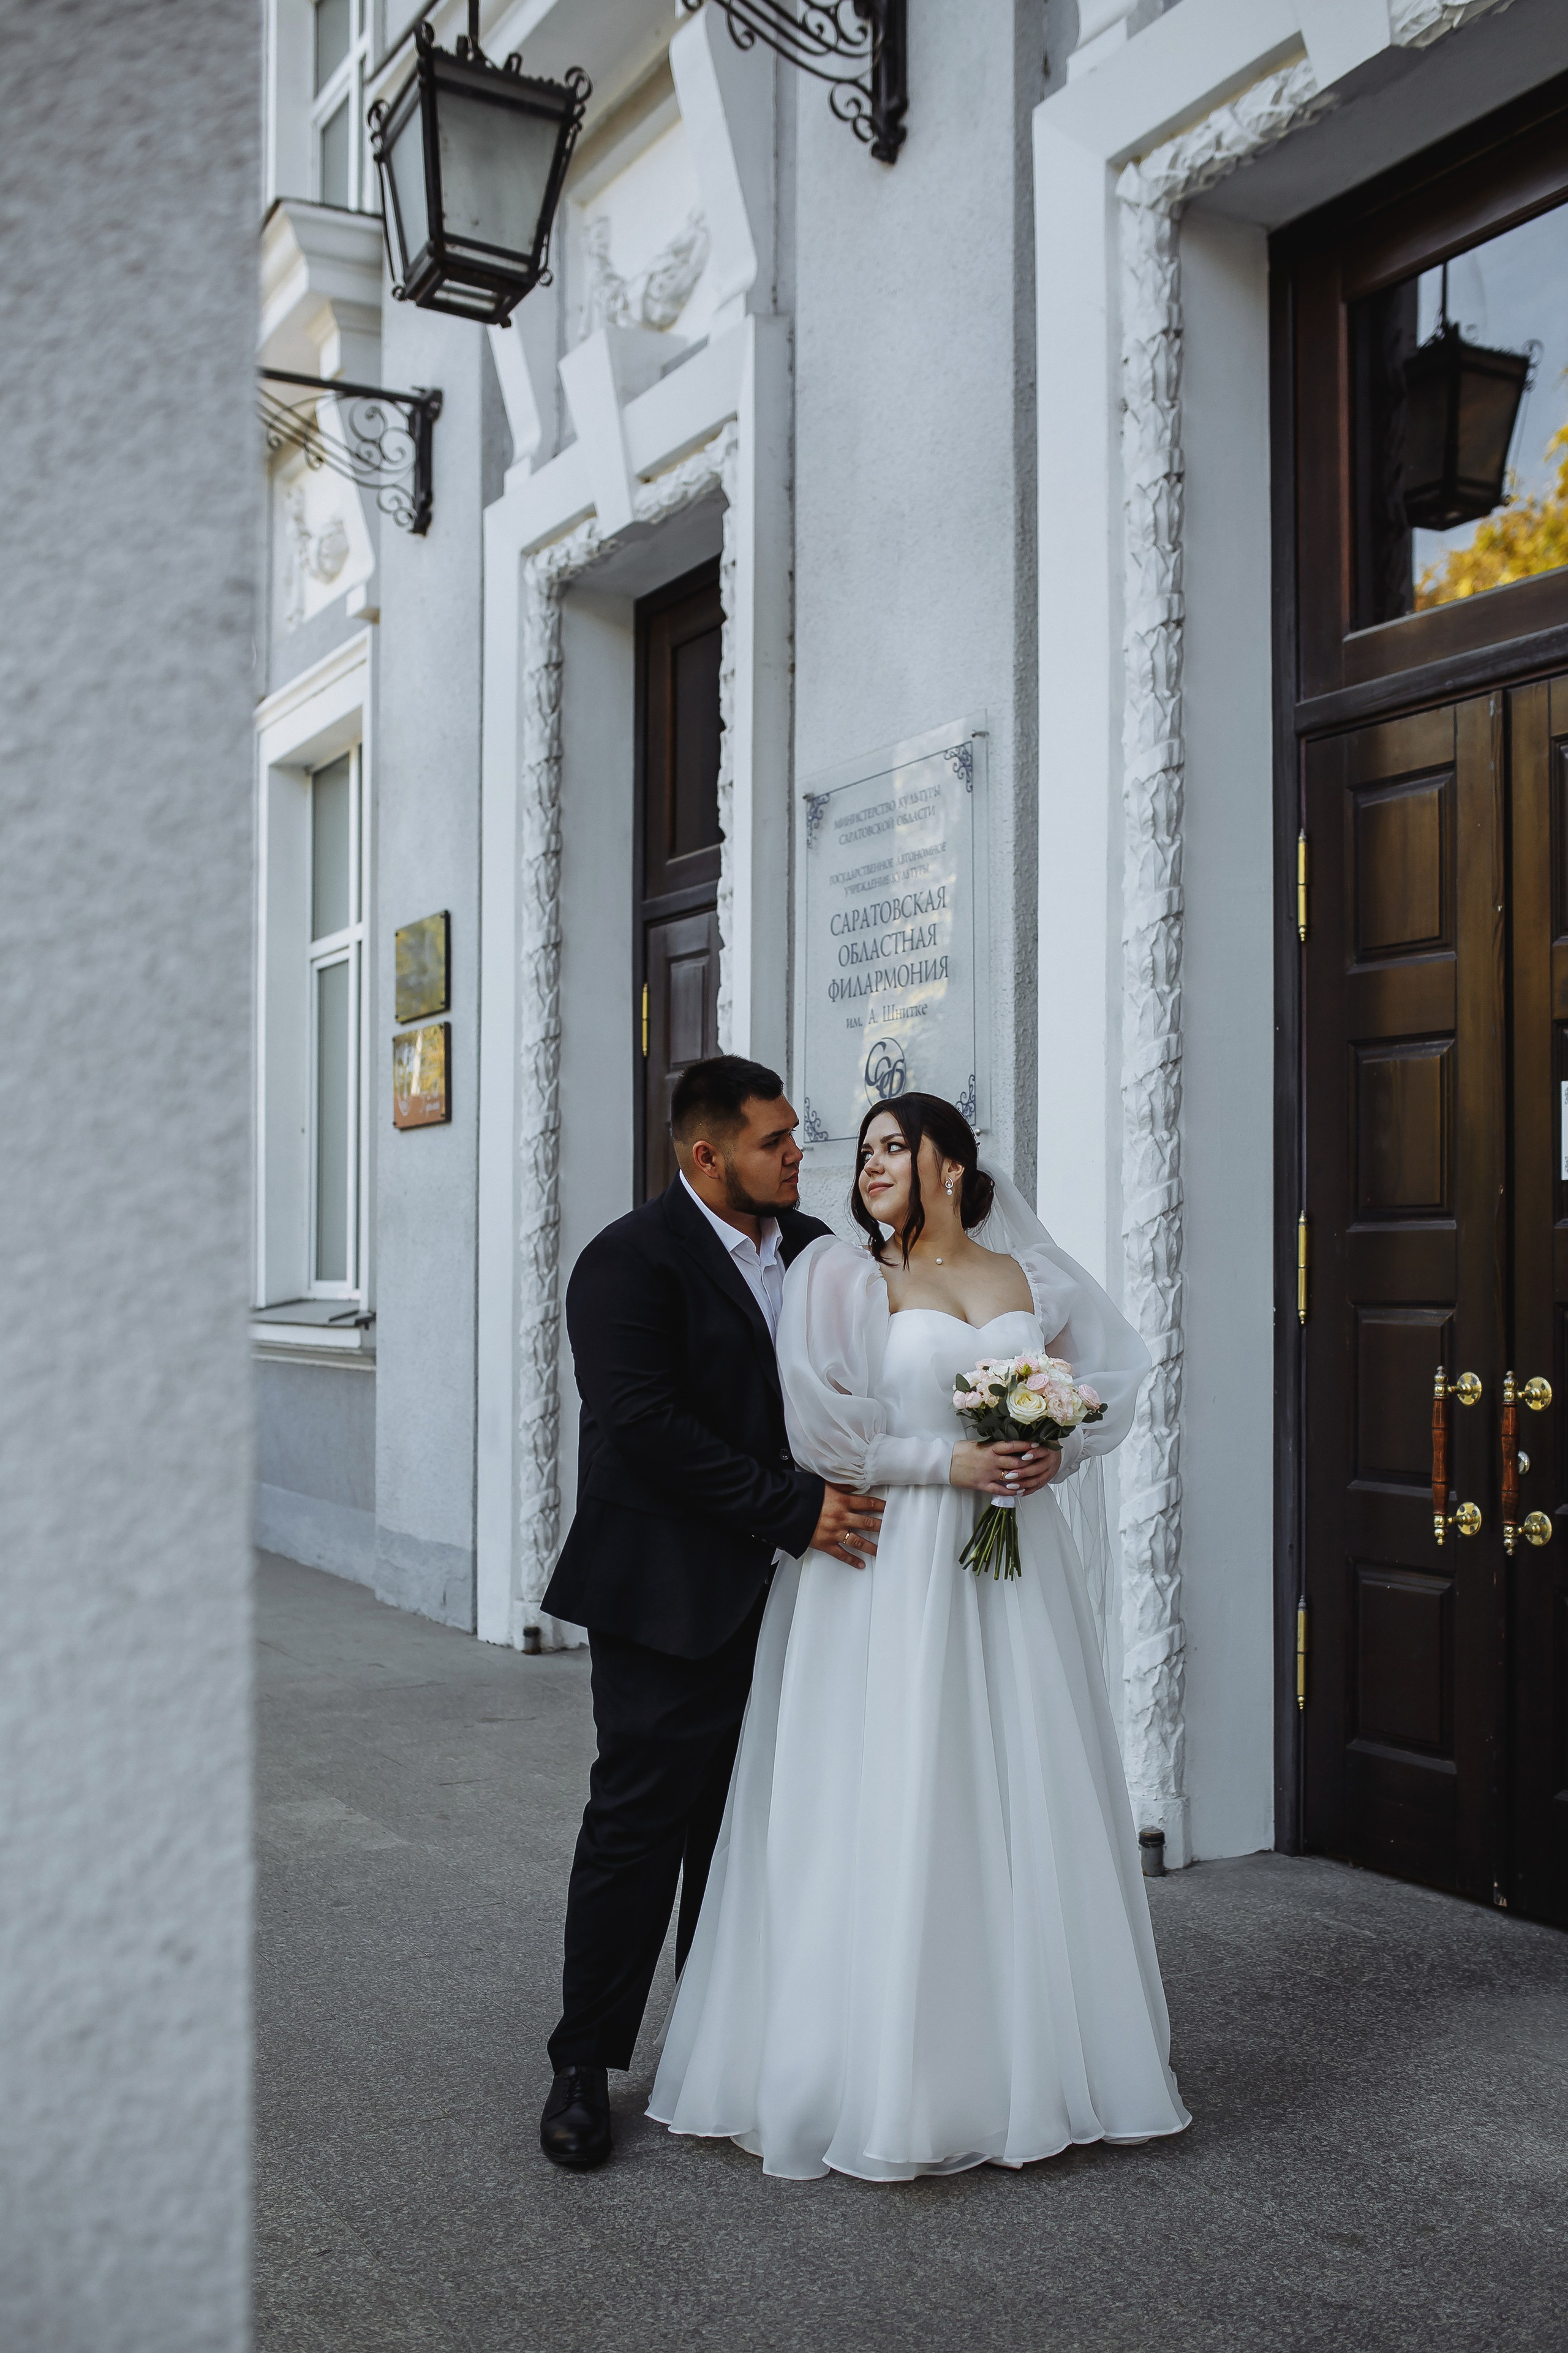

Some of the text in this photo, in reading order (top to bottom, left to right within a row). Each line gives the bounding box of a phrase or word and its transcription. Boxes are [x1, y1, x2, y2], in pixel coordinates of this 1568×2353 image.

[830, 885, 947, 936] САРАТОВСКАЯ
[838, 923, 937, 967] ОБЛАСТНАЯ
[828, 955, 949, 1003] ФИЛАРМОНИЯ
[846, 1003, 928, 1029] им. А. Шнитке
